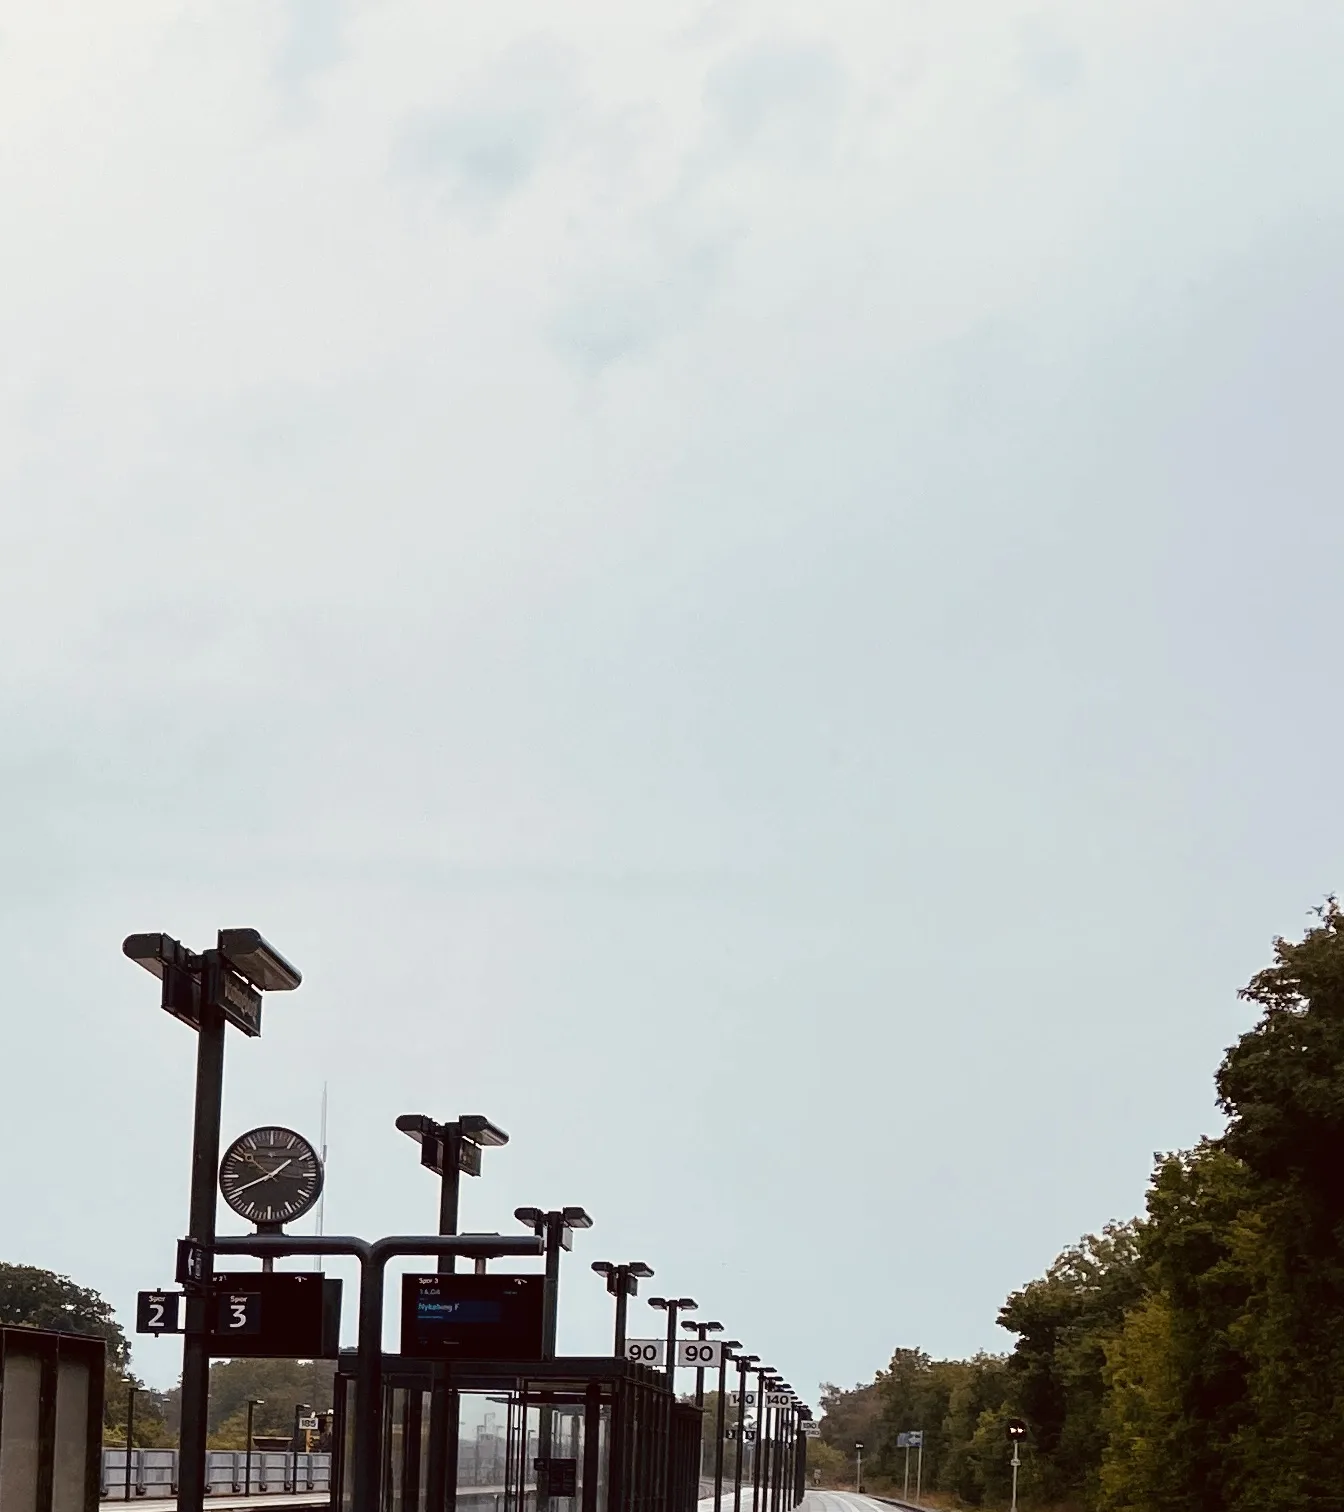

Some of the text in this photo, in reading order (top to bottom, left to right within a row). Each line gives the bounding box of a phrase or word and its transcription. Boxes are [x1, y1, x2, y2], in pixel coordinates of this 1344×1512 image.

[229, 1295, 248, 1303] Spor
[148, 1304, 164, 1327] 2
[229, 1304, 247, 1328] 3
[629, 1344, 657, 1361] 90
[685, 1345, 713, 1361] 90
[766, 1395, 789, 1405] 140
